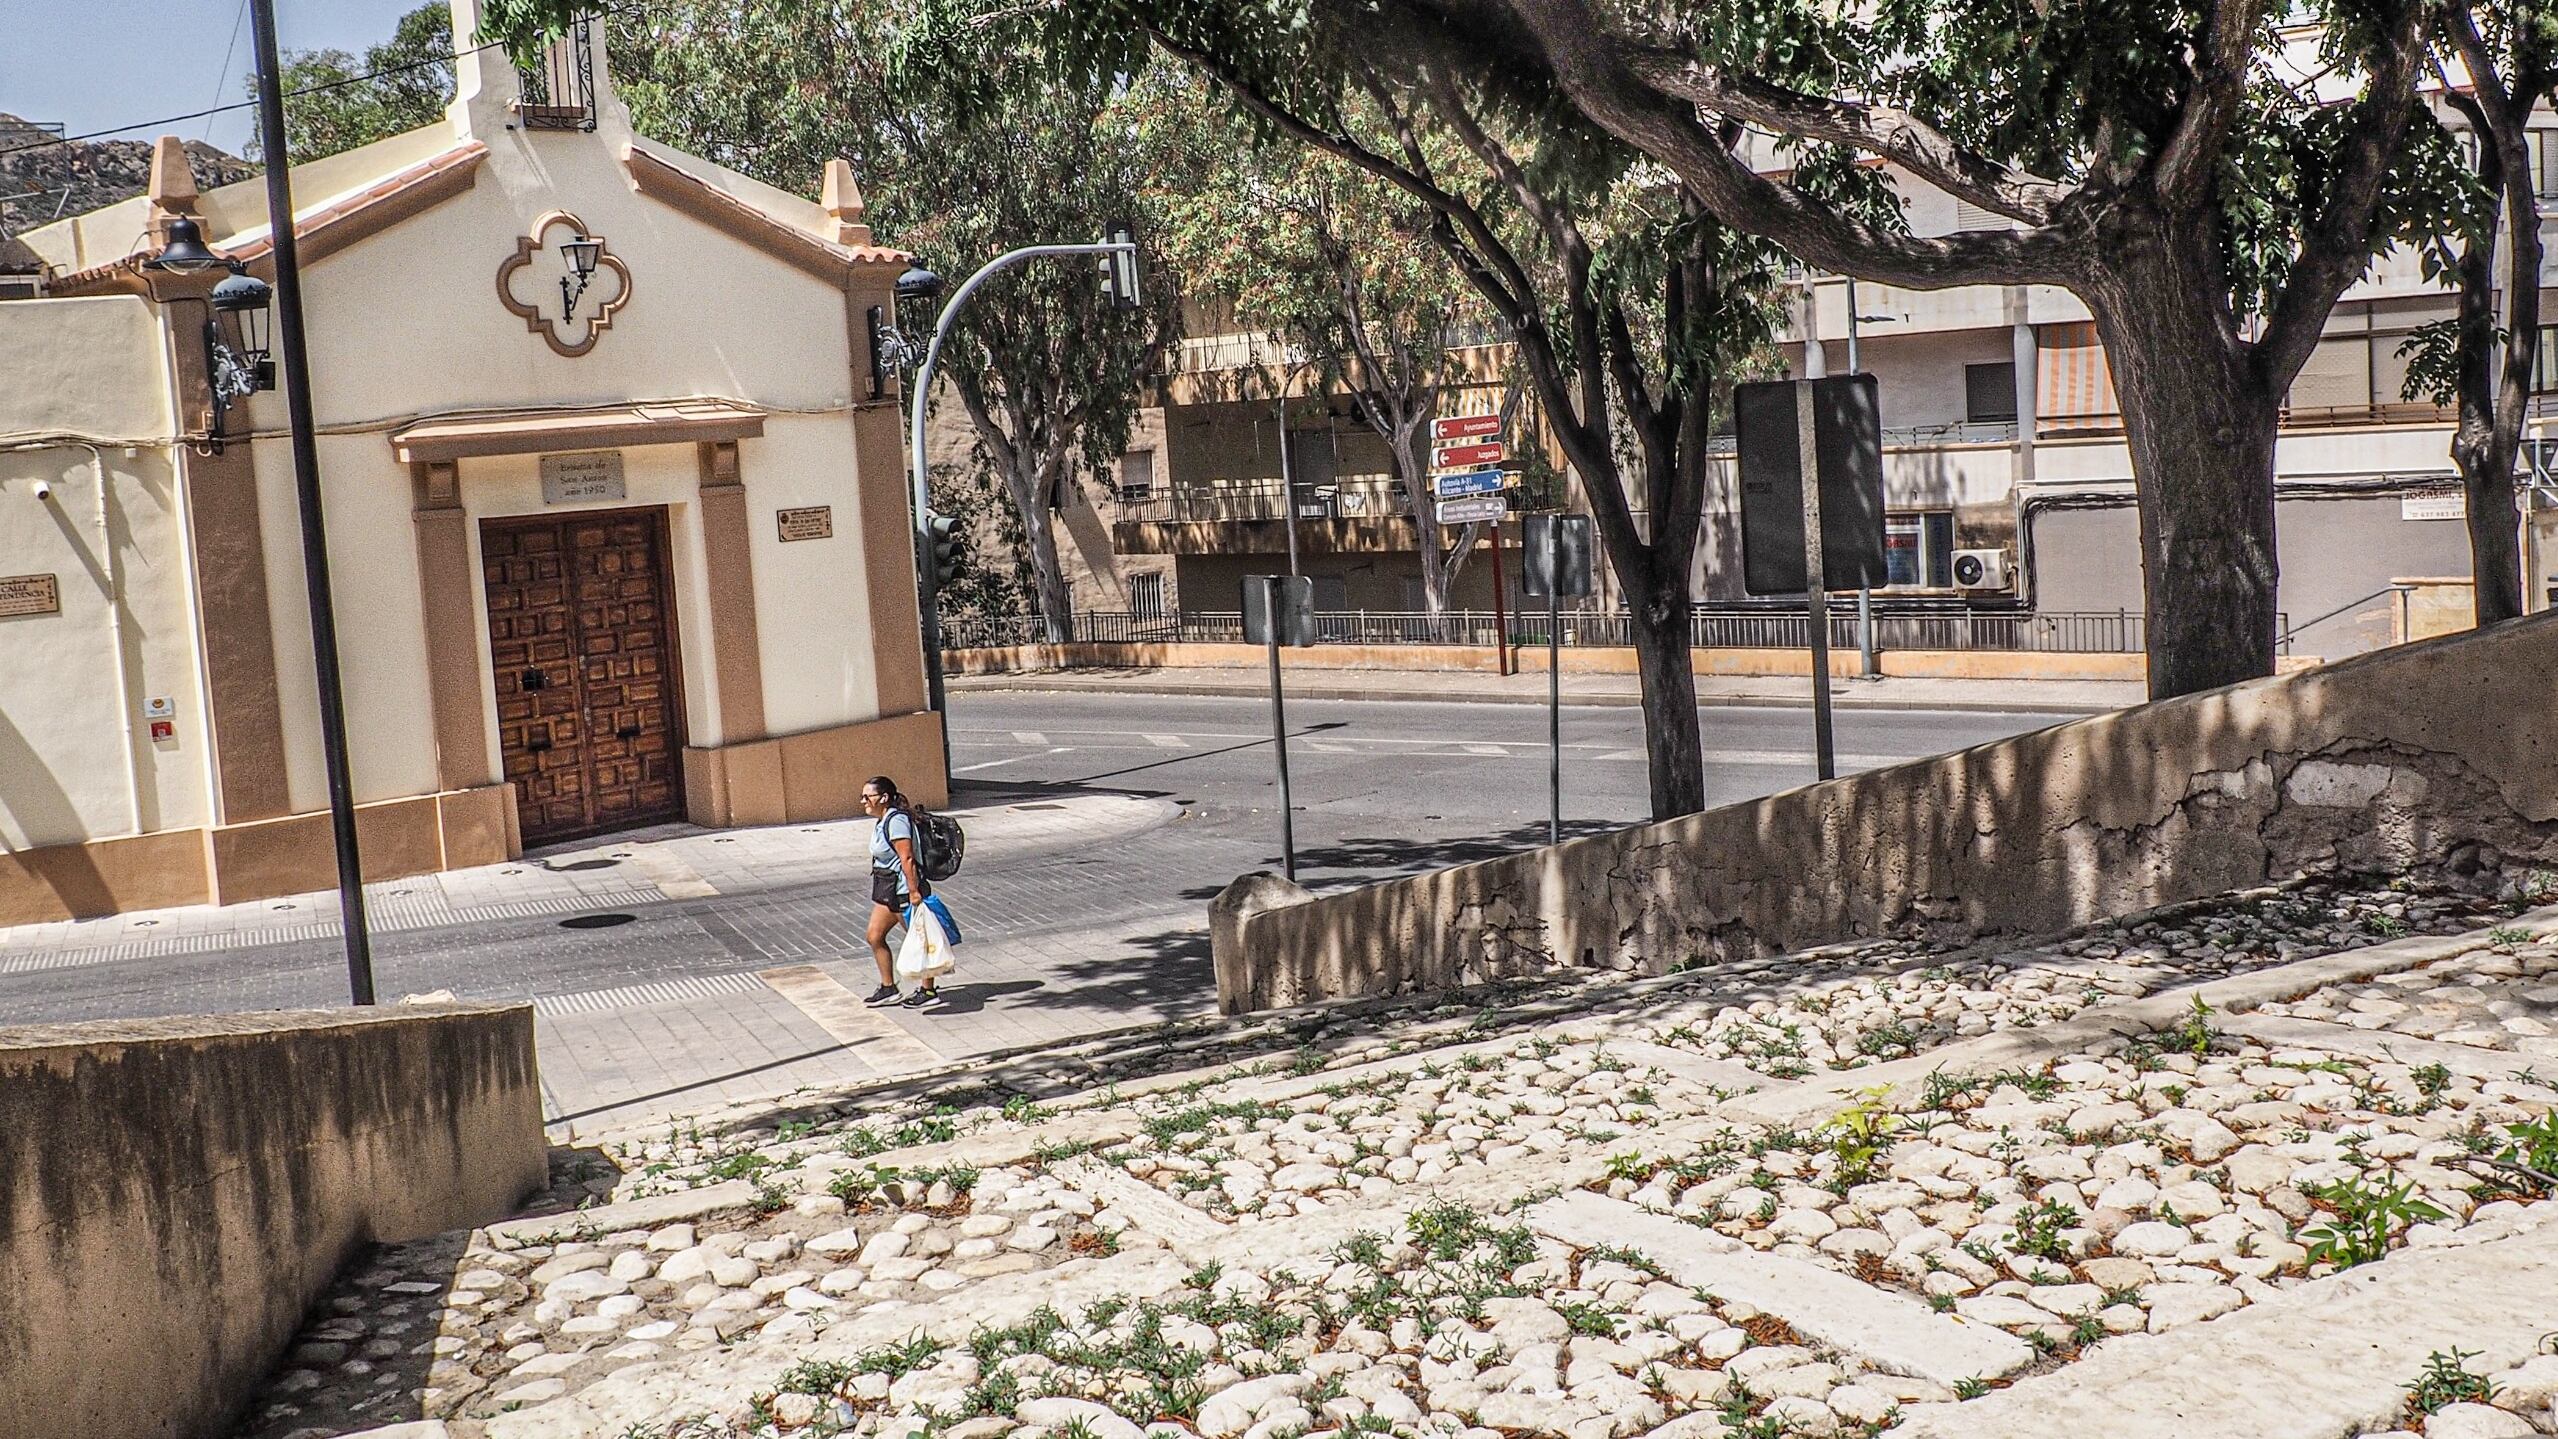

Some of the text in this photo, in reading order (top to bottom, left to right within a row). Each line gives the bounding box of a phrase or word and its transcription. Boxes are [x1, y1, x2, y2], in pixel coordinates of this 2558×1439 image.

[1464, 420, 1498, 433] Ayuntamiento
[595, 458, 606, 469] de
[584, 485, 606, 495] 1950
[1465, 483, 1482, 492] Madrid
[1, 584, 28, 593] CALLE
